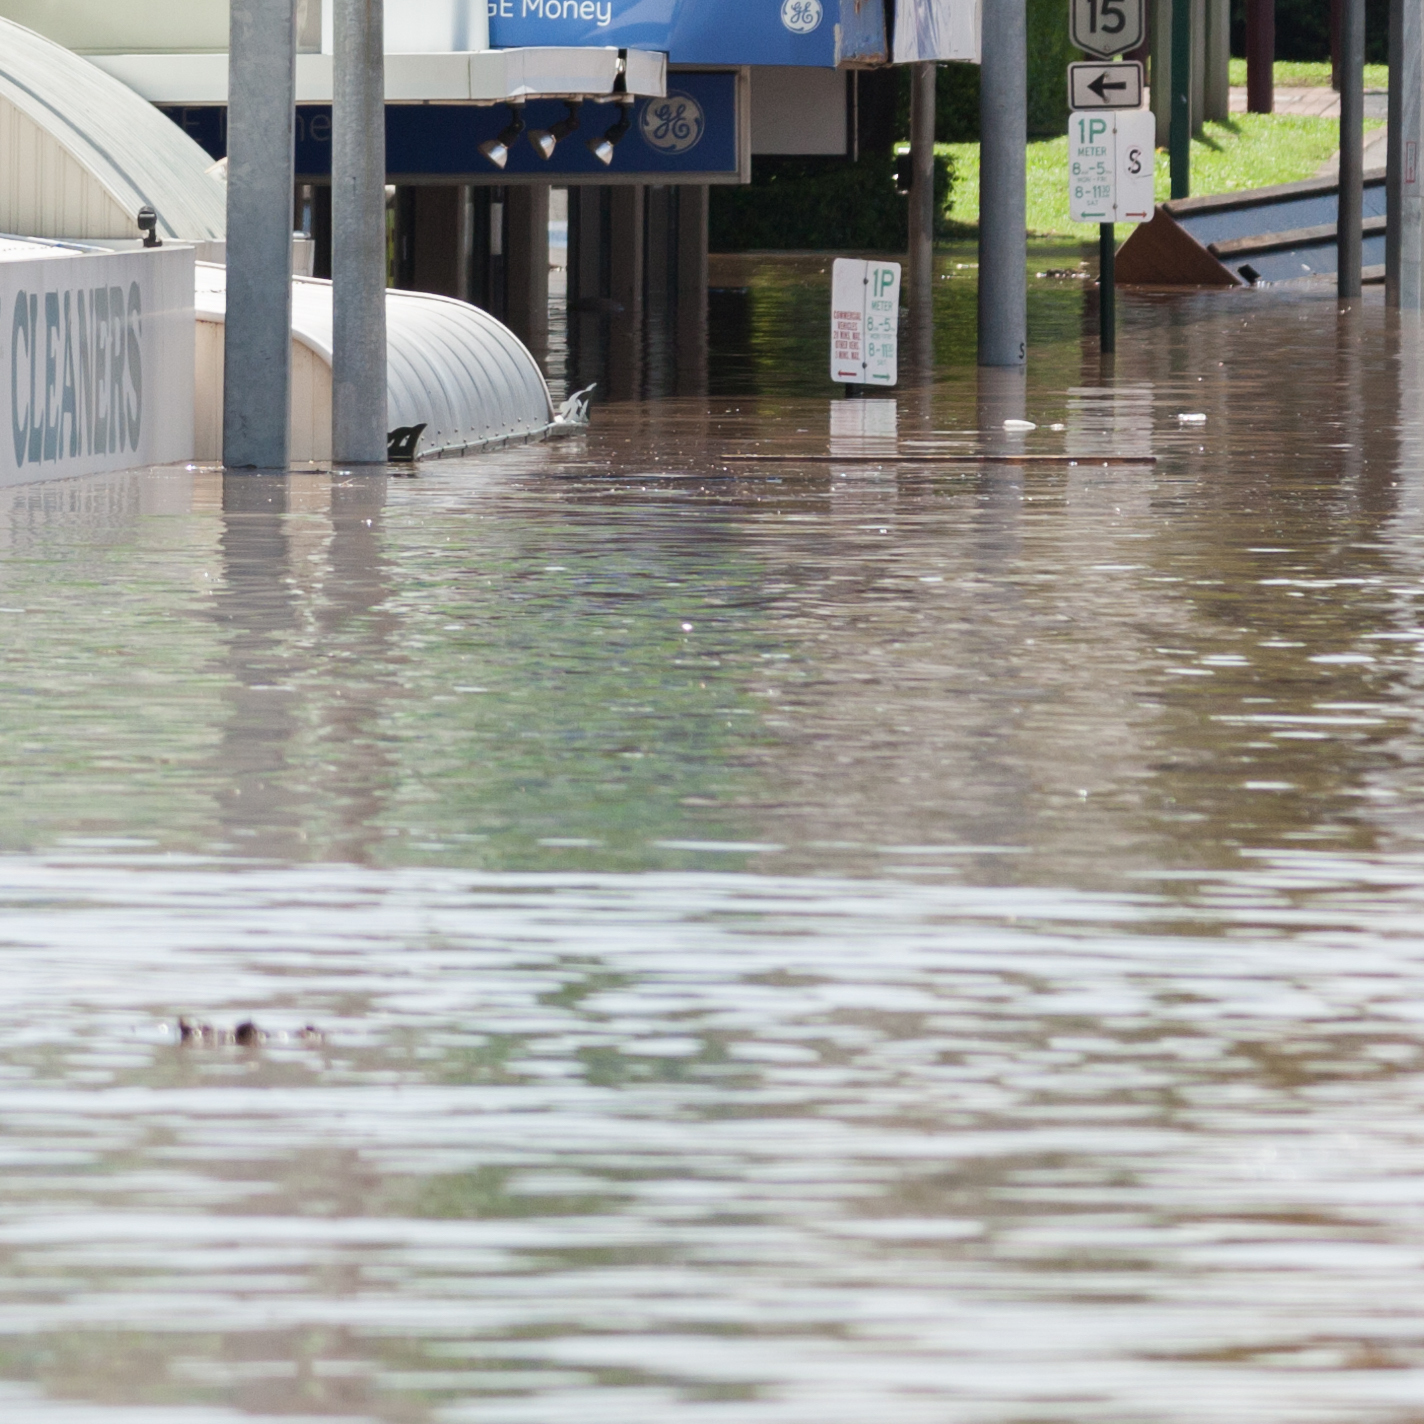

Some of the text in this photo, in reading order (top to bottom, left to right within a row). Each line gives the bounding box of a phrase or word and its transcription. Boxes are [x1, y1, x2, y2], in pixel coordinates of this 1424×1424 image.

[1078, 118, 1107, 144] 1P
[1077, 146, 1107, 157] METER
[873, 267, 895, 297] 1P
[871, 299, 893, 311] METER
[10, 279, 143, 468] CLEANERS
